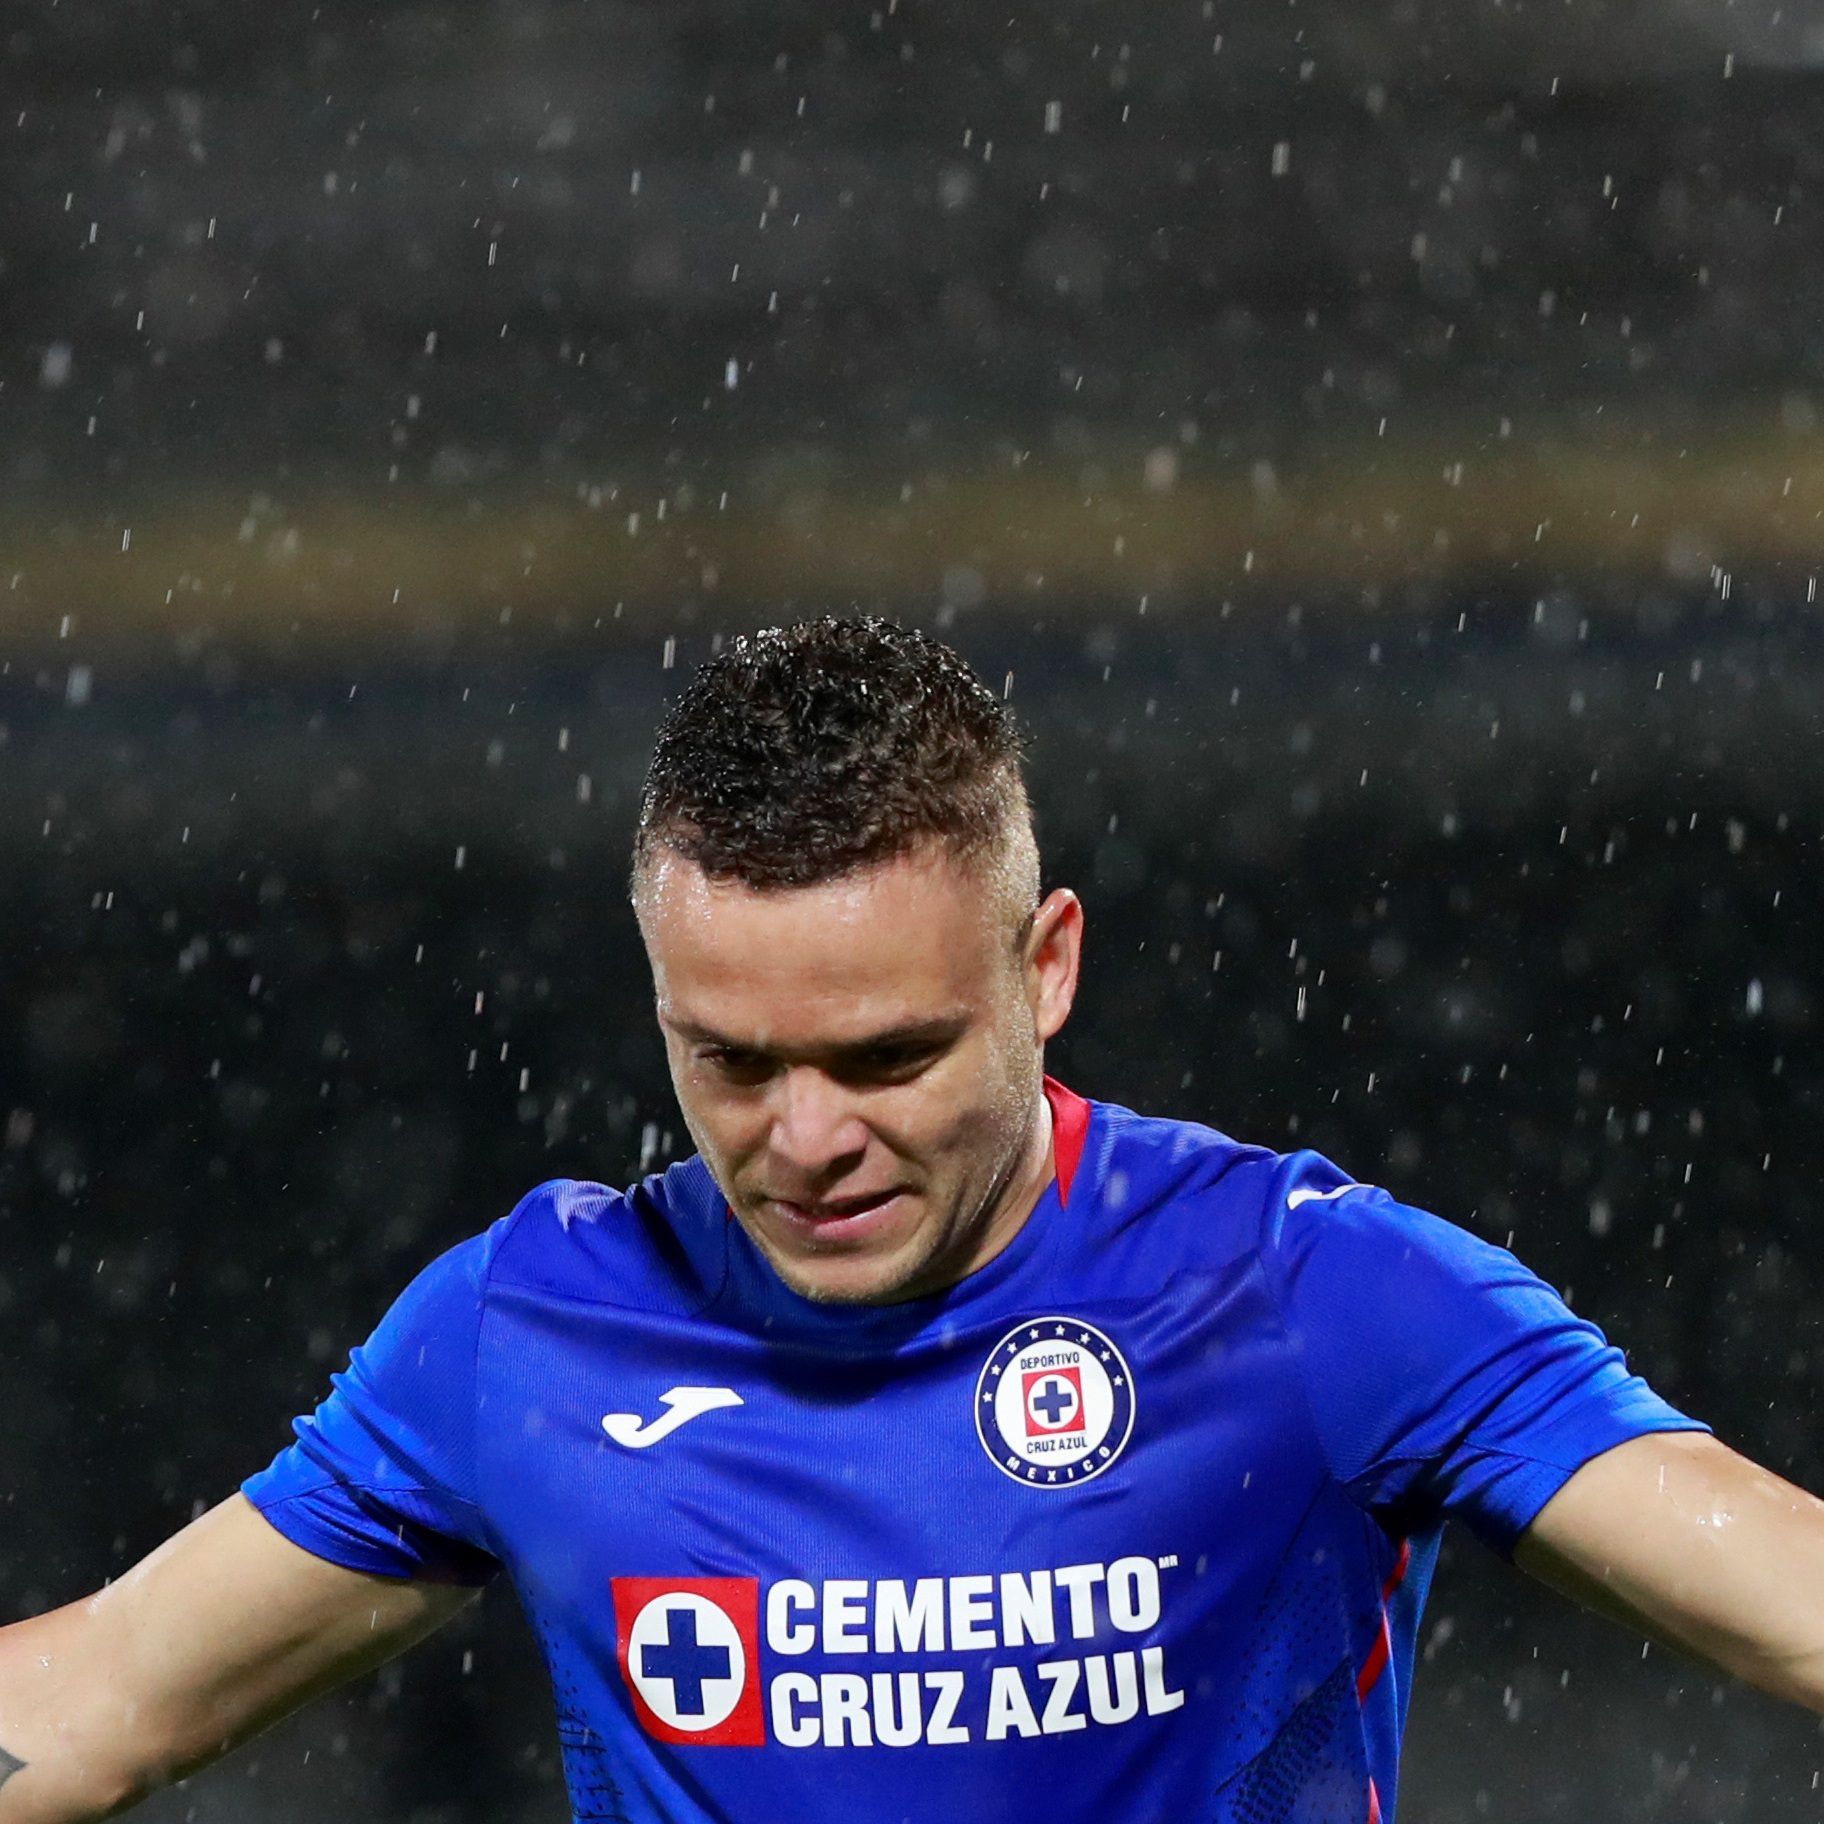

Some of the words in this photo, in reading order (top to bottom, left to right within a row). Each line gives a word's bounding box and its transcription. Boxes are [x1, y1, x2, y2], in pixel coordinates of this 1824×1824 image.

[1020, 1351, 1080, 1370] DEPORTIVO
[1006, 1445, 1112, 1482] MEXICO
[1026, 1439, 1055, 1454] CRUZ
[1058, 1436, 1088, 1450] AZUL
[766, 1555, 1161, 1656] CEMENTO
[767, 1669, 970, 1749] CRUZ
[984, 1646, 1185, 1741] AZUL
